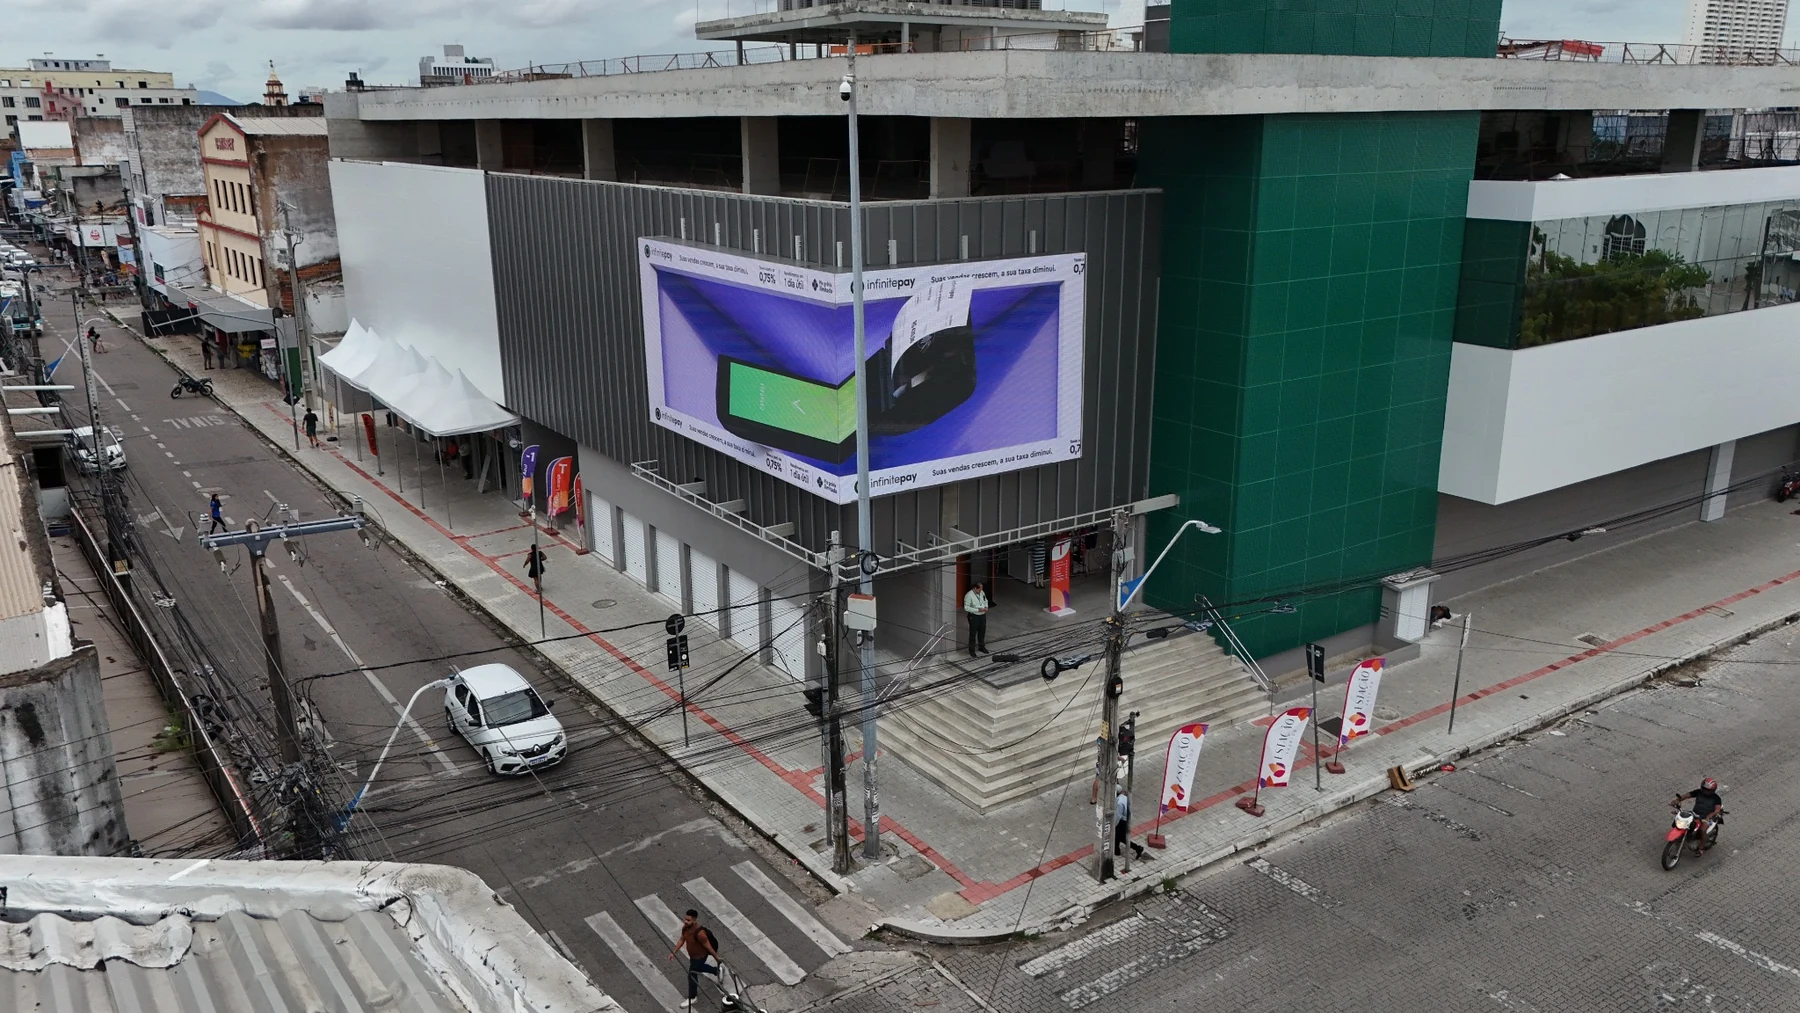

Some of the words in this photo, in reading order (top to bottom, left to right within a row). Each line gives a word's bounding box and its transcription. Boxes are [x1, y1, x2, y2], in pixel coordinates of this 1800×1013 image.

[759, 271, 776, 284] 0,75%
[931, 275, 946, 284] Suas
[1032, 264, 1057, 274] diminui.
[787, 278, 795, 289] dia
[867, 277, 915, 290] infinitepay
[162, 415, 225, 430] SINAL
[558, 463, 568, 474] T
[766, 458, 782, 472] 0,75%
[932, 469, 947, 477] Suas
[948, 464, 971, 474] vendas
[971, 458, 999, 469] crescem,
[1005, 455, 1015, 463] sua
[1016, 451, 1029, 461] taxa
[1029, 447, 1053, 459] diminui.
[793, 470, 801, 481] dia
[870, 473, 917, 488] infinitepay
[1274, 718, 1295, 760] ESTAÇÃO
